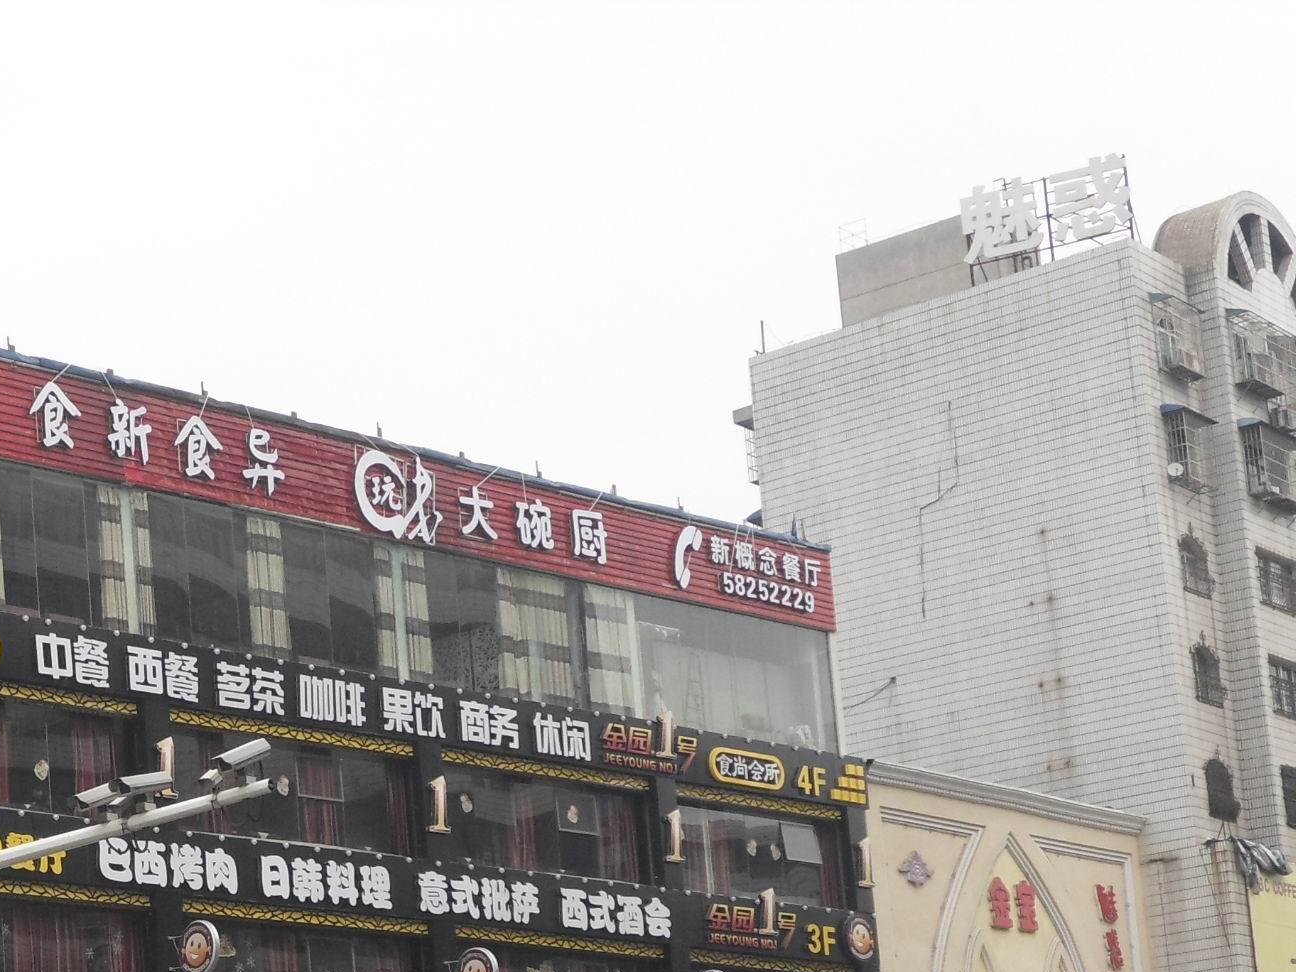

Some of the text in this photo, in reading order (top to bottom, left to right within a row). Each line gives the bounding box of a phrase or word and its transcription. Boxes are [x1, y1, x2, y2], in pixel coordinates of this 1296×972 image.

[960, 153, 1132, 264] 魅惑
[29, 381, 285, 497] 食新食异
[459, 490, 608, 565] 大碗厨
[710, 535, 822, 589] 新概念餐厅
[722, 572, 816, 614] 58252229
[34, 634, 592, 763] 中餐 西餐 茗茶 咖啡 果饮 商务 休闲
[604, 753, 657, 771] JEEYOUNG
[716, 754, 827, 797] 食尚会所 4F
[98, 837, 672, 938] 巴西烤肉 日韩料理 意式批萨 西式酒会
[709, 933, 759, 949] JEEYOUNG
[807, 923, 836, 956] 3F
